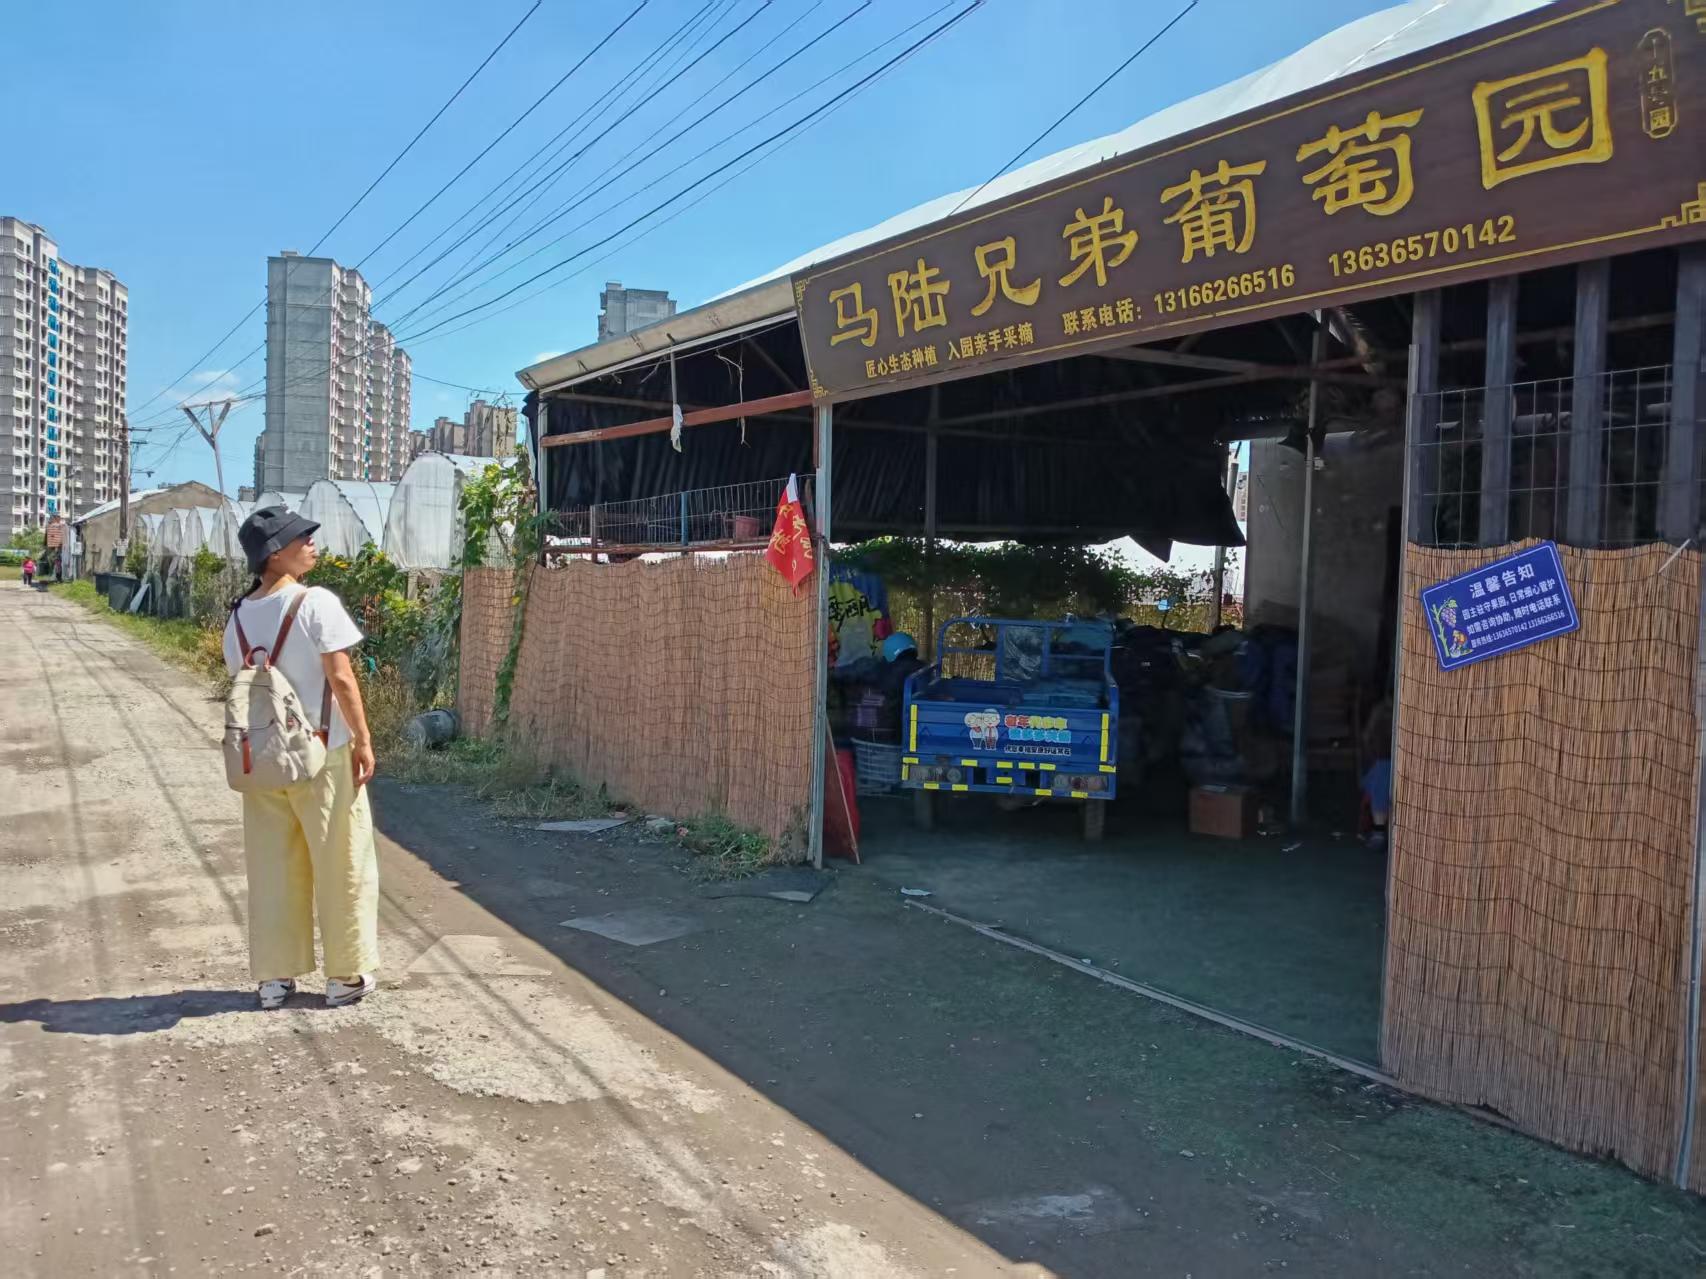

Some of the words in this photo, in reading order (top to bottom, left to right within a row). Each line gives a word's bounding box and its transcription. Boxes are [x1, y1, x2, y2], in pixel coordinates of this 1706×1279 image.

[829, 46, 1613, 348] 马陆兄弟葡萄园
[1154, 263, 1295, 314] 13166266516
[1328, 214, 1516, 276] 13636570142
[864, 344, 938, 379] 匠心生态种植
[947, 321, 1034, 361] 入园亲手采摘
[1469, 563, 1535, 598] 温馨告知
